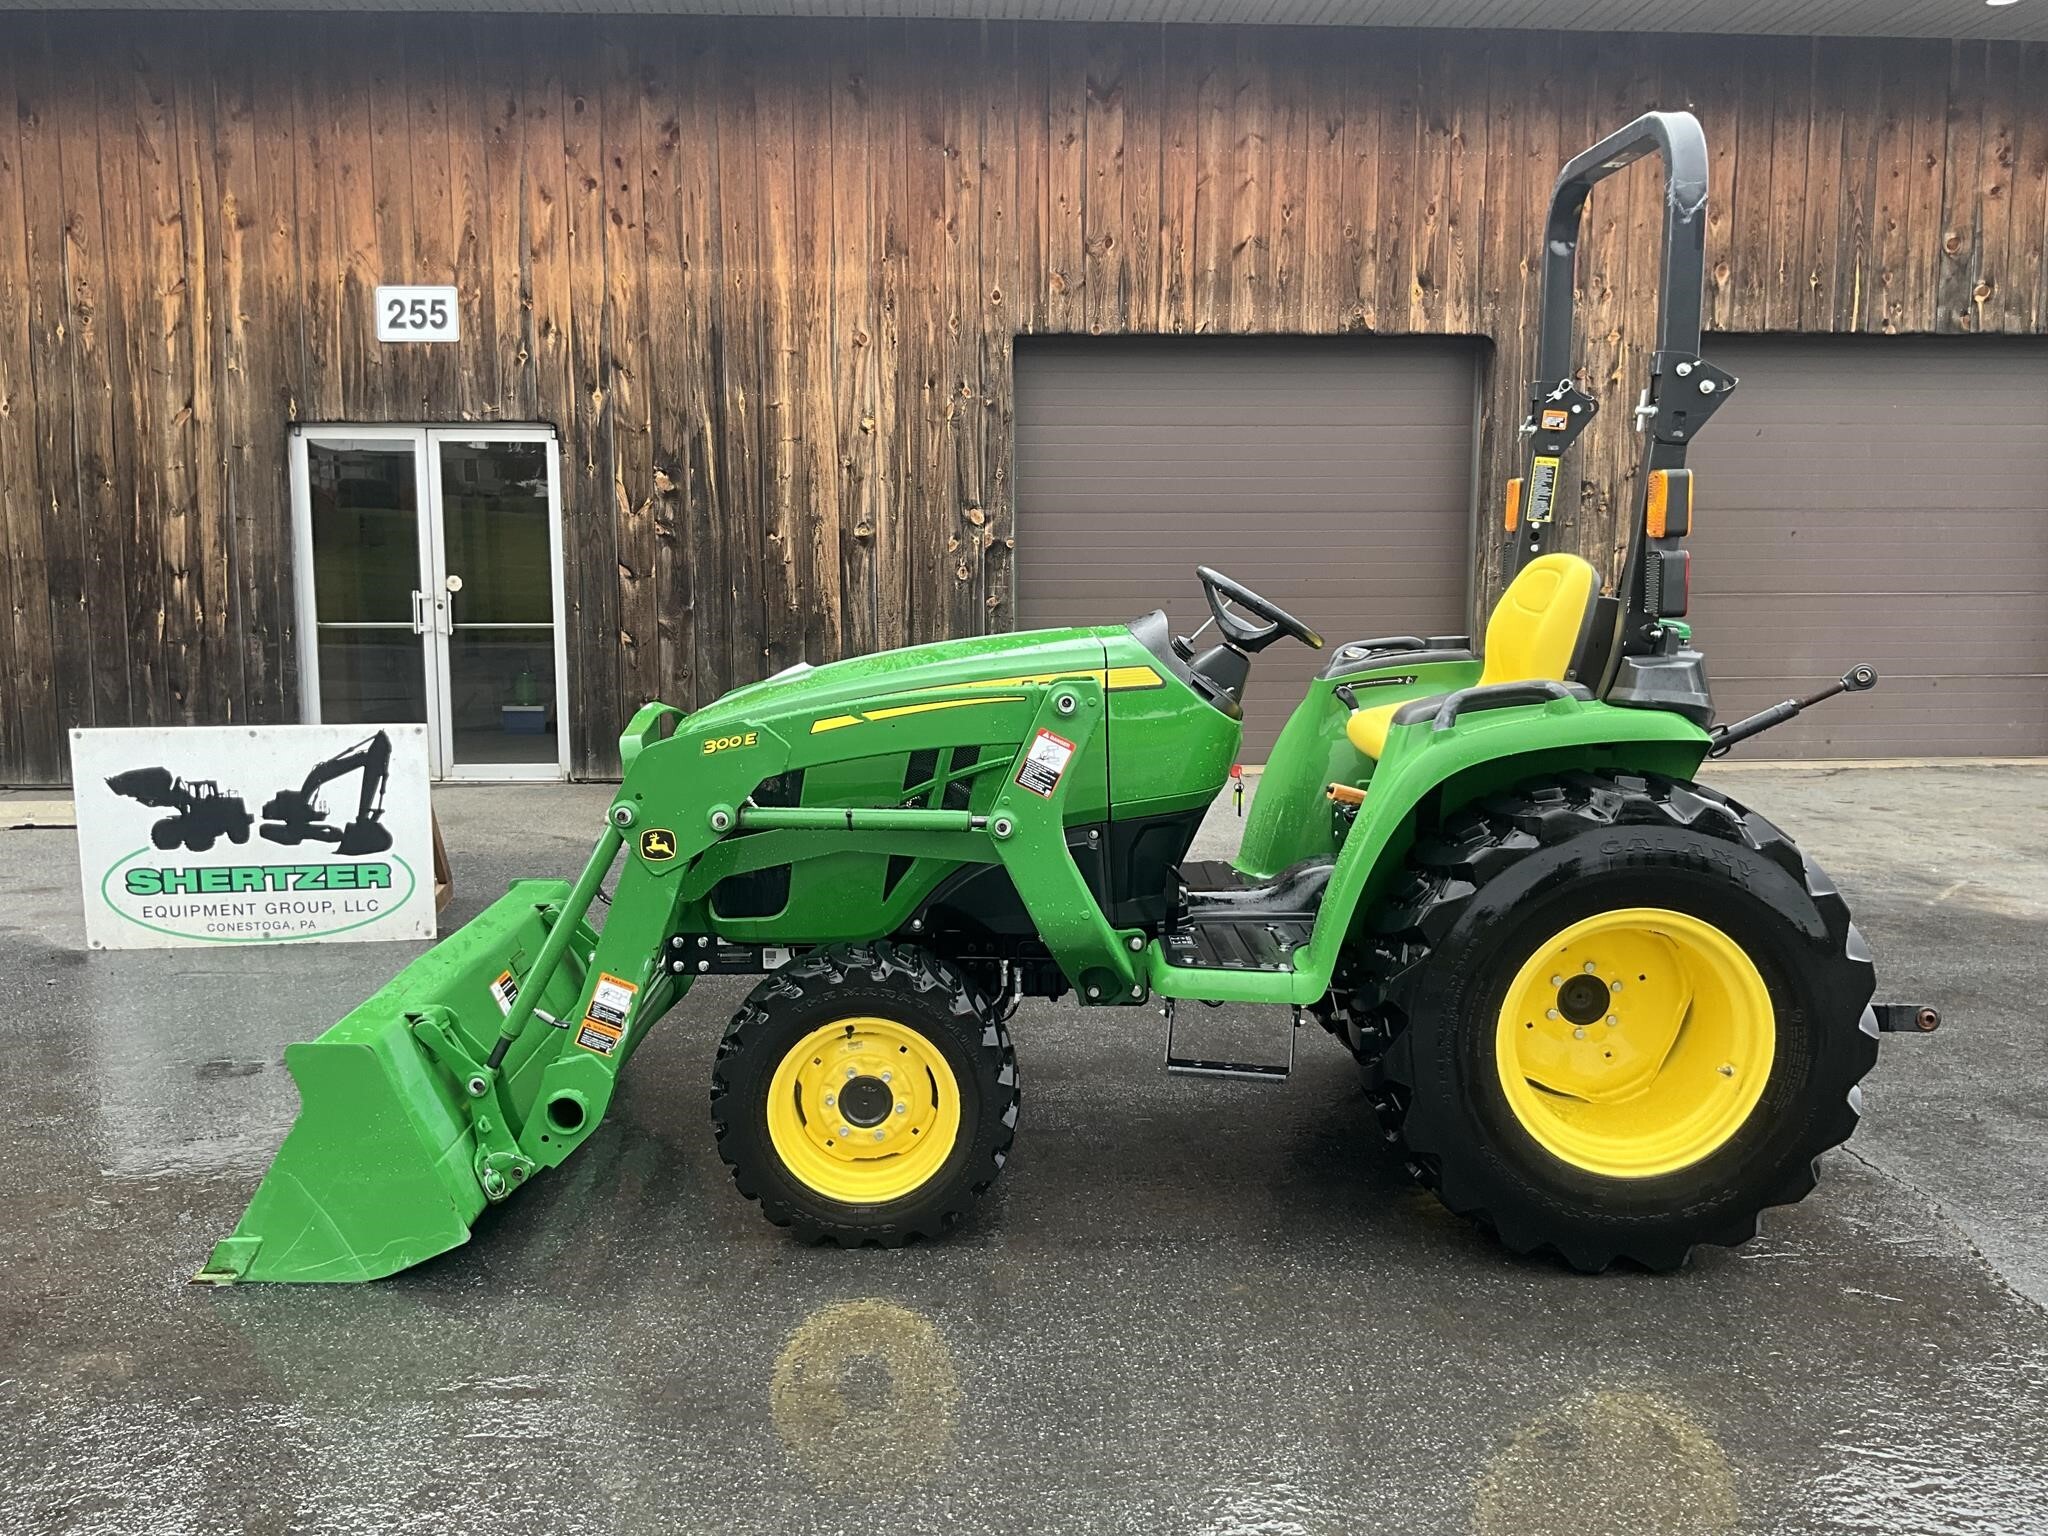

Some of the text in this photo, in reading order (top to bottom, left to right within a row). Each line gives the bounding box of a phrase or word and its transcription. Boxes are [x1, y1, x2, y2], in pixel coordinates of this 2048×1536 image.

[388, 299, 448, 329] 255
[1600, 838, 1759, 877] GALAXY
[125, 863, 392, 896] SHERTZER
[142, 899, 379, 919] EQUIPMENT GROUP, LLC
[207, 920, 317, 933] CONESTOGA, PA
